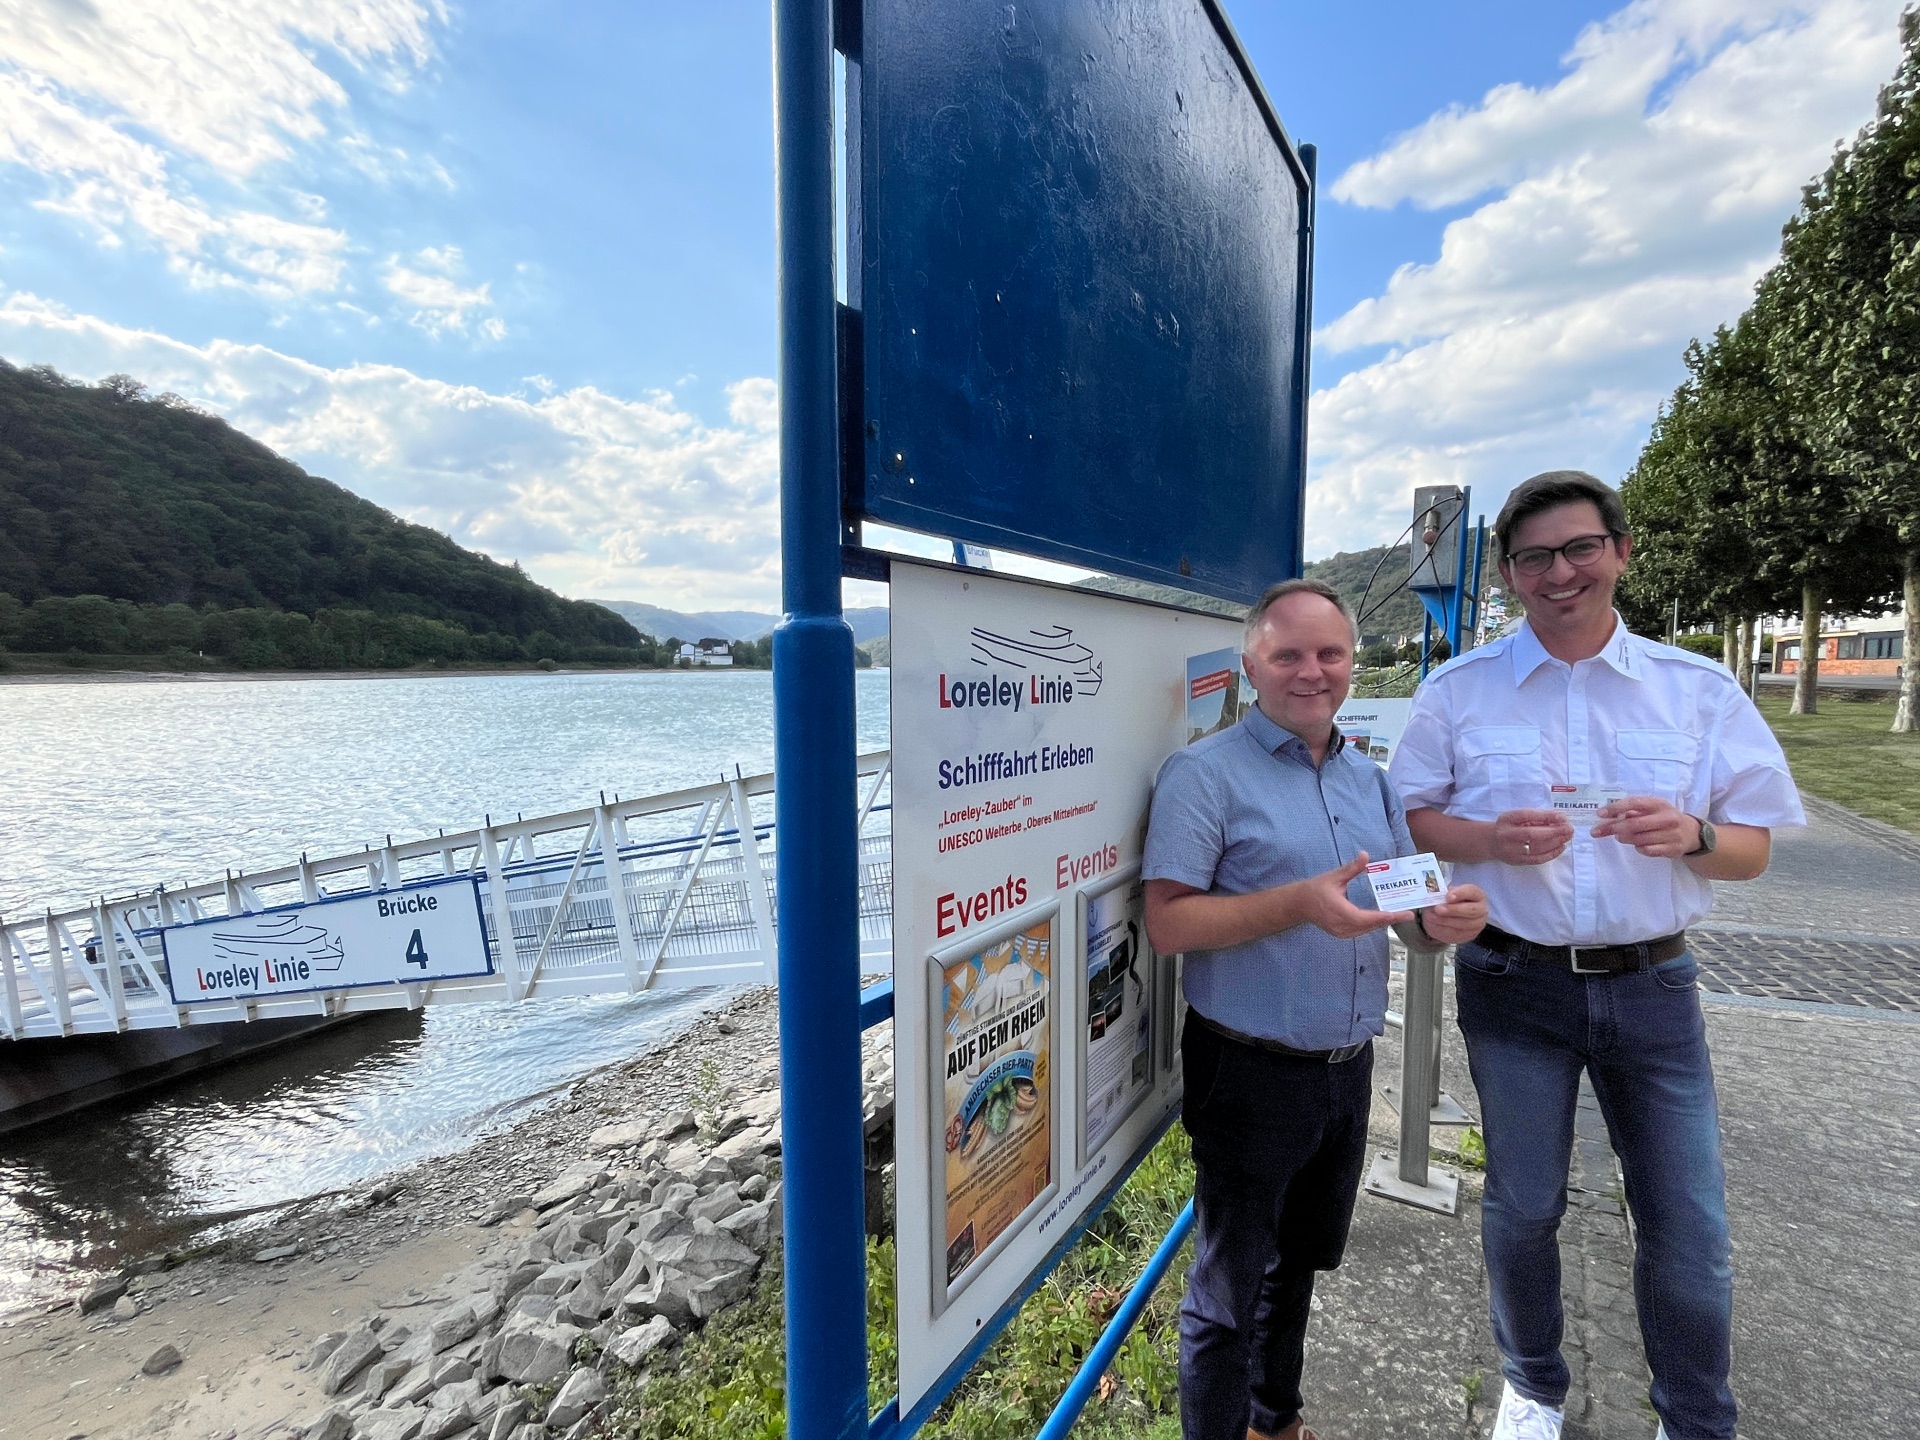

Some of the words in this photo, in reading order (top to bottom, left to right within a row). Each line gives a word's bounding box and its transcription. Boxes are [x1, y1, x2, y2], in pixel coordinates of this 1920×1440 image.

[939, 674, 1024, 712] Loreley
[1031, 675, 1073, 704] Linie
[938, 750, 1038, 789] Schifffahrt
[1041, 743, 1094, 772] Erleben
[1023, 794, 1033, 807] im
[938, 828, 983, 853] UNESCO
[985, 820, 1022, 840] Welterbe
[1056, 841, 1118, 890] Events
[1375, 878, 1418, 892] FREIKARTE
[377, 893, 438, 917] Brücke
[937, 874, 1028, 938] Events
[405, 928, 429, 970] 4
[197, 963, 260, 991] Loreley
[264, 956, 311, 984] Linie
[947, 1038, 976, 1080] AUF
[978, 1020, 1009, 1059] DEM
[1011, 996, 1046, 1039] RHEIN
[965, 1064, 1001, 1116] ANDECHSER
[1039, 1154, 1107, 1234] www.loreley-linie.de
